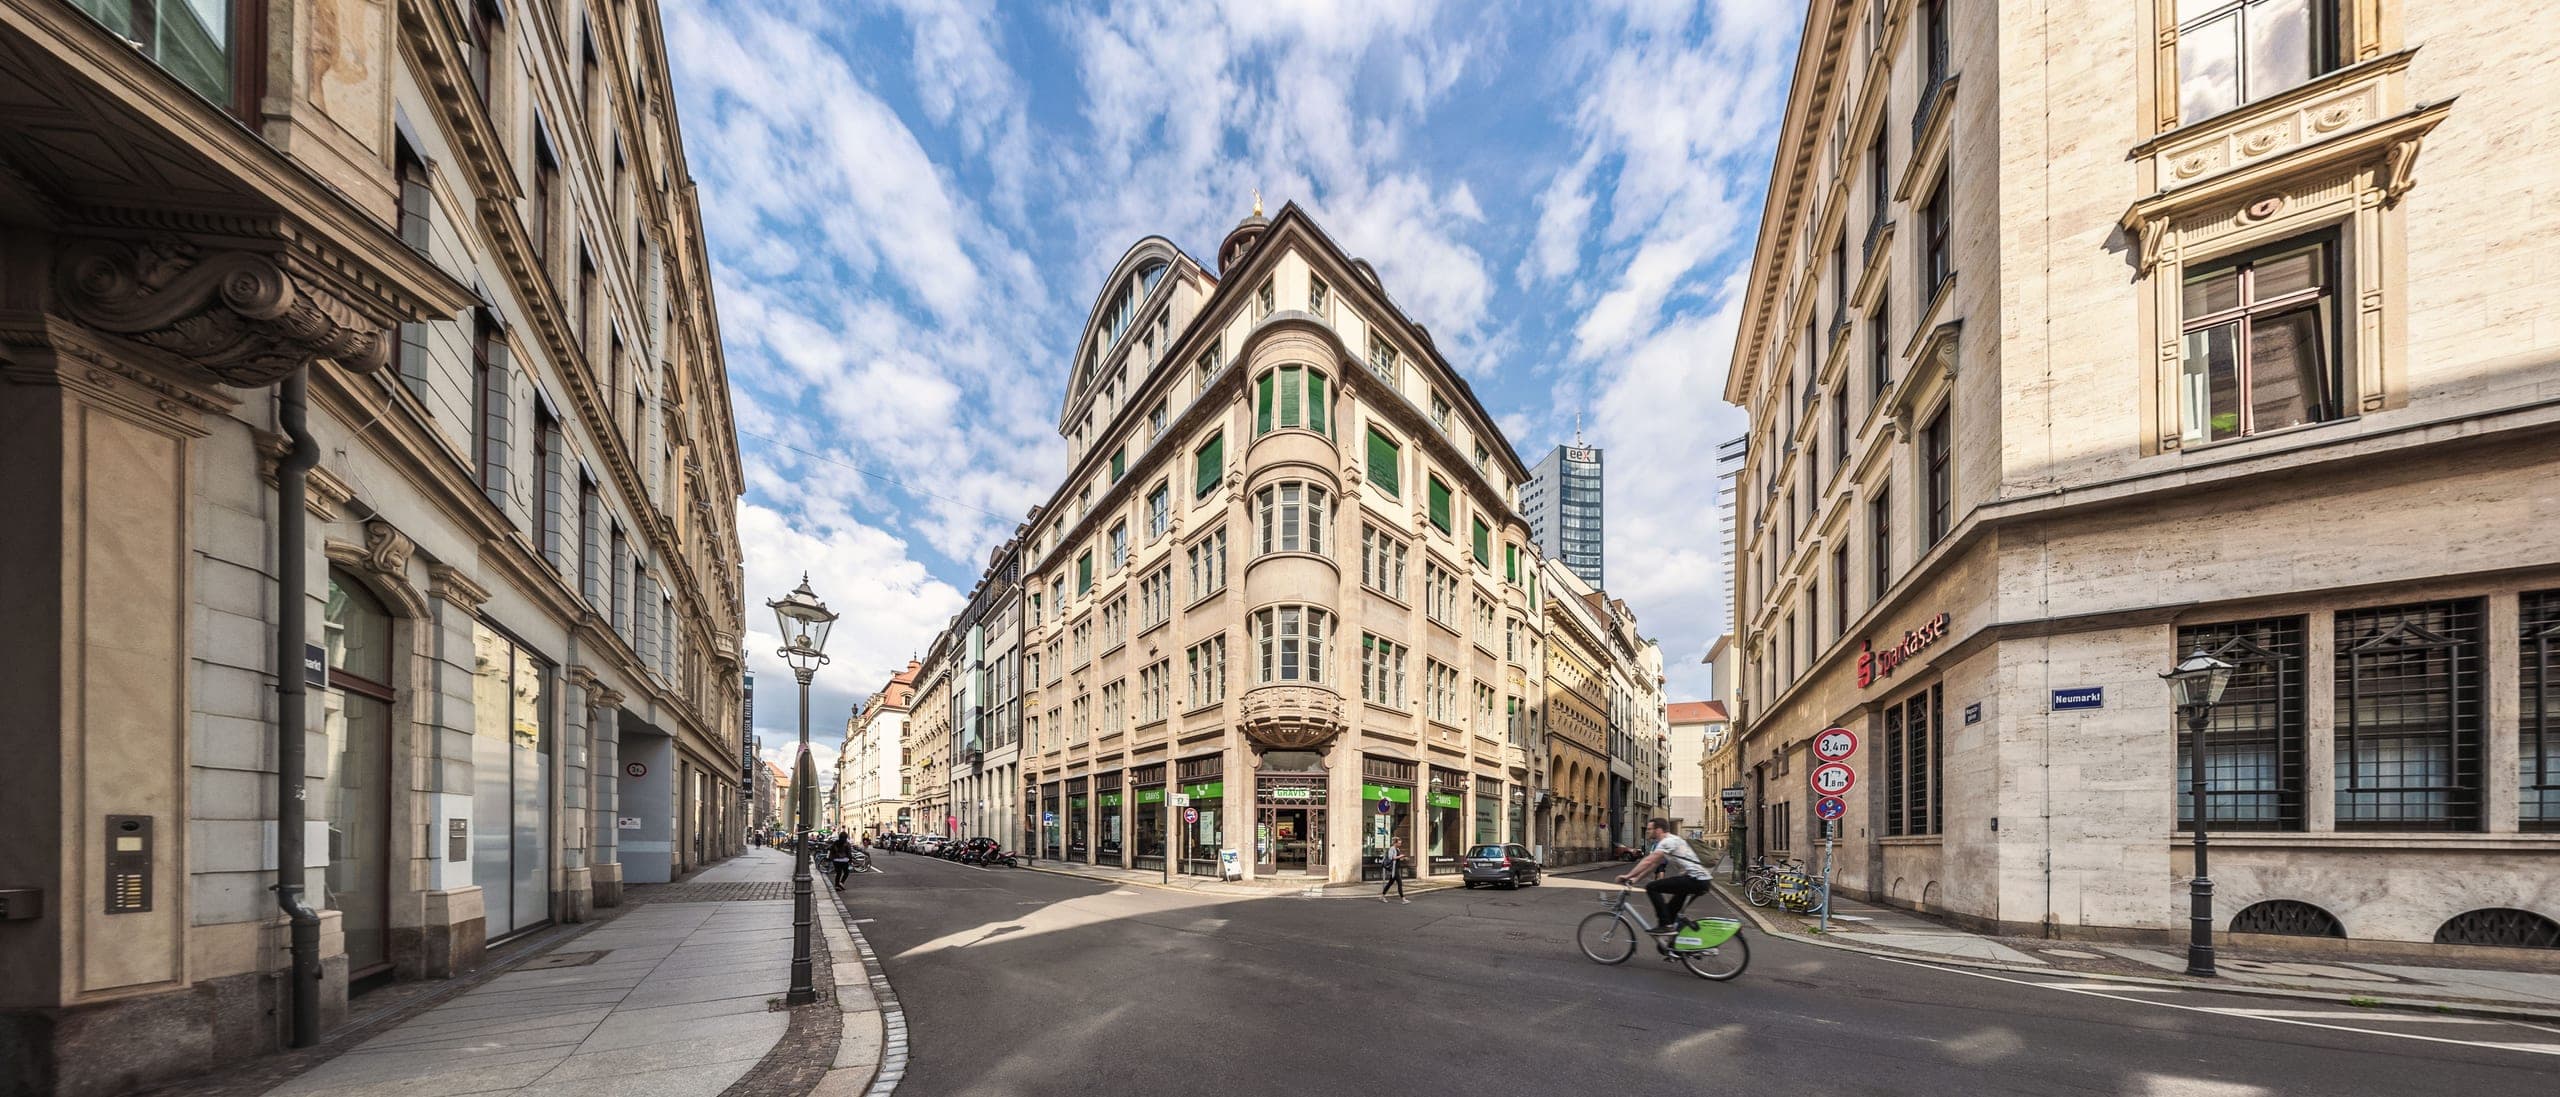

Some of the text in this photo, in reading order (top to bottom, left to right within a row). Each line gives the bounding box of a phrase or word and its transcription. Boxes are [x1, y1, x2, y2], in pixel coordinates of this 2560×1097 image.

[1570, 450, 1590, 461] eex
[1878, 613, 1949, 677] Sparkasse
[2056, 693, 2100, 704] Neumarkt
[1277, 788, 1306, 797] GRAVIS
